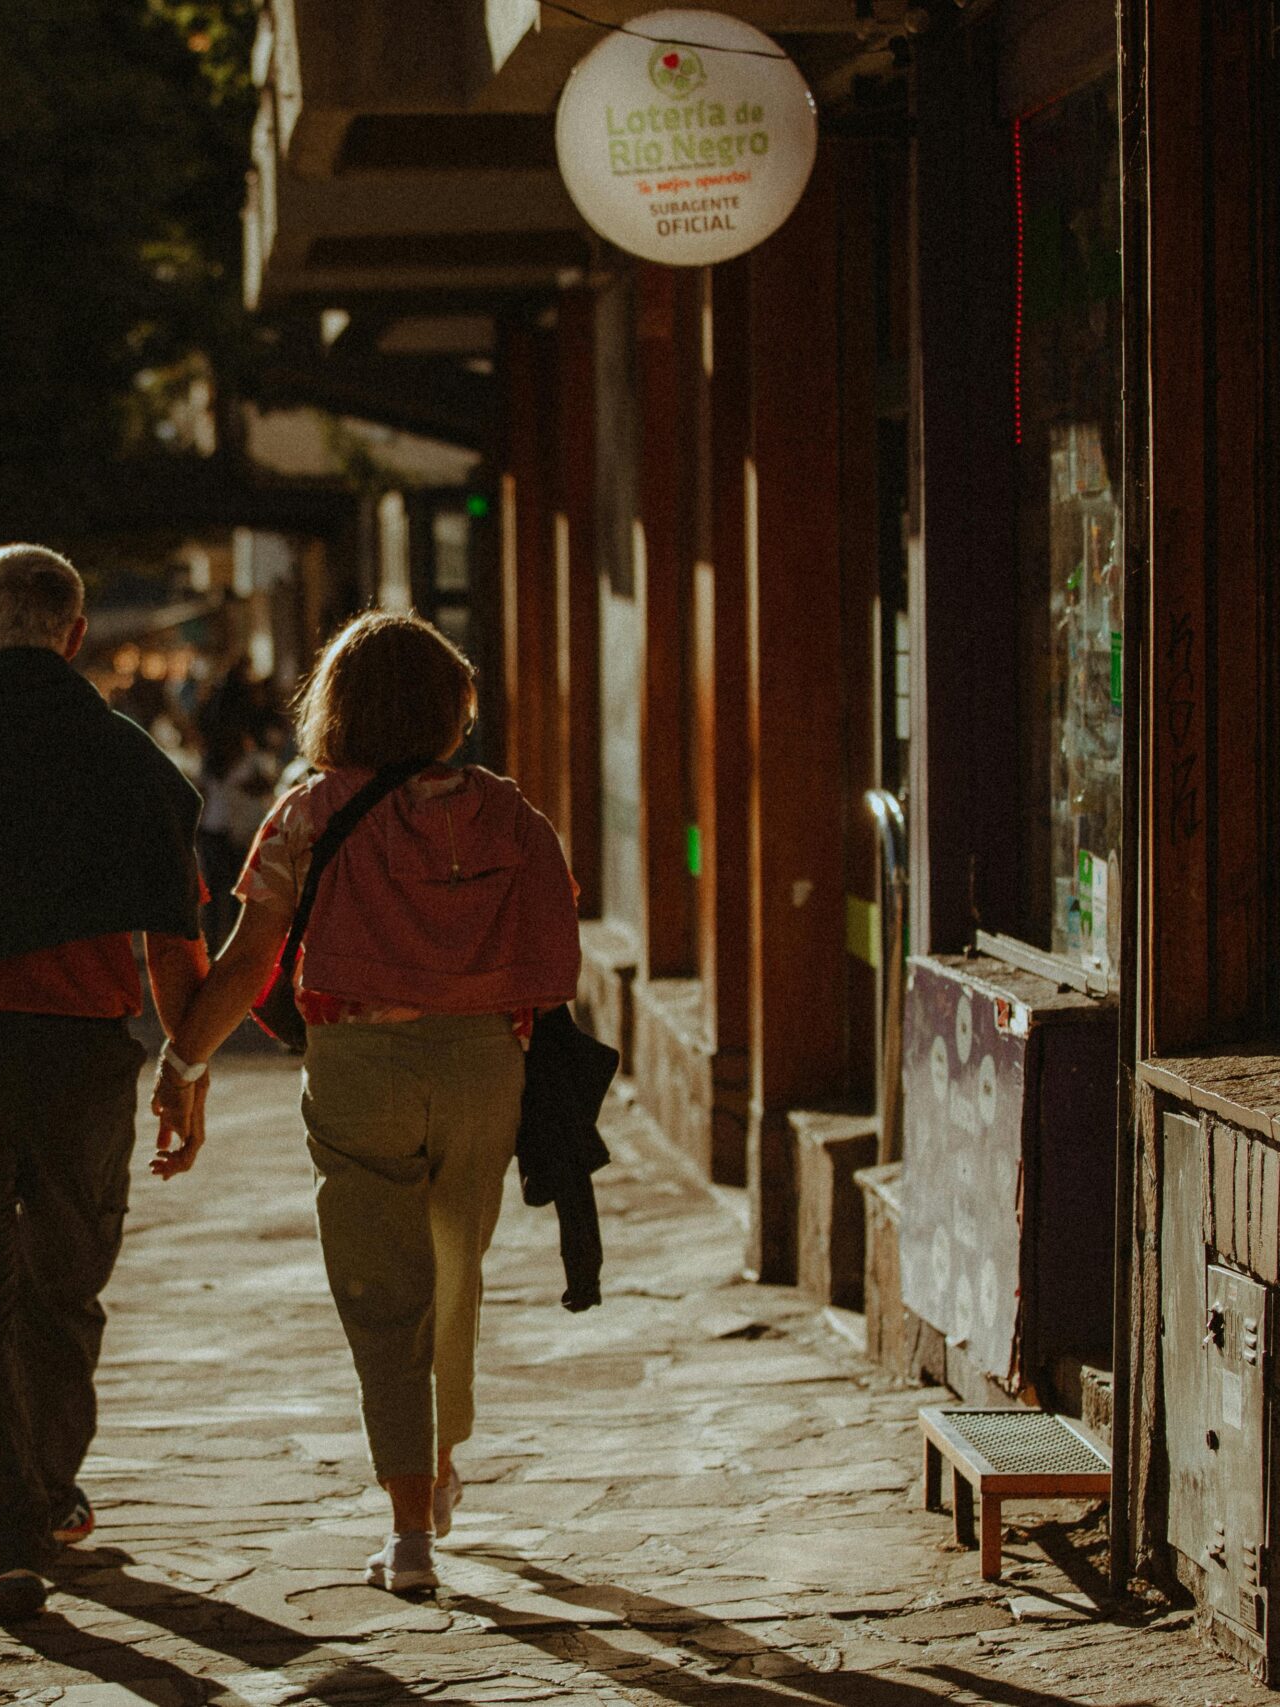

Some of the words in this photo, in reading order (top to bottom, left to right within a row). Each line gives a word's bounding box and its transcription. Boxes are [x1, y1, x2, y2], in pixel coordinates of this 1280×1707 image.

[735, 101, 764, 125] de
[671, 130, 769, 168] Negro
[650, 196, 740, 217] SUBAGENTE
[657, 214, 736, 237] OFICIAL
